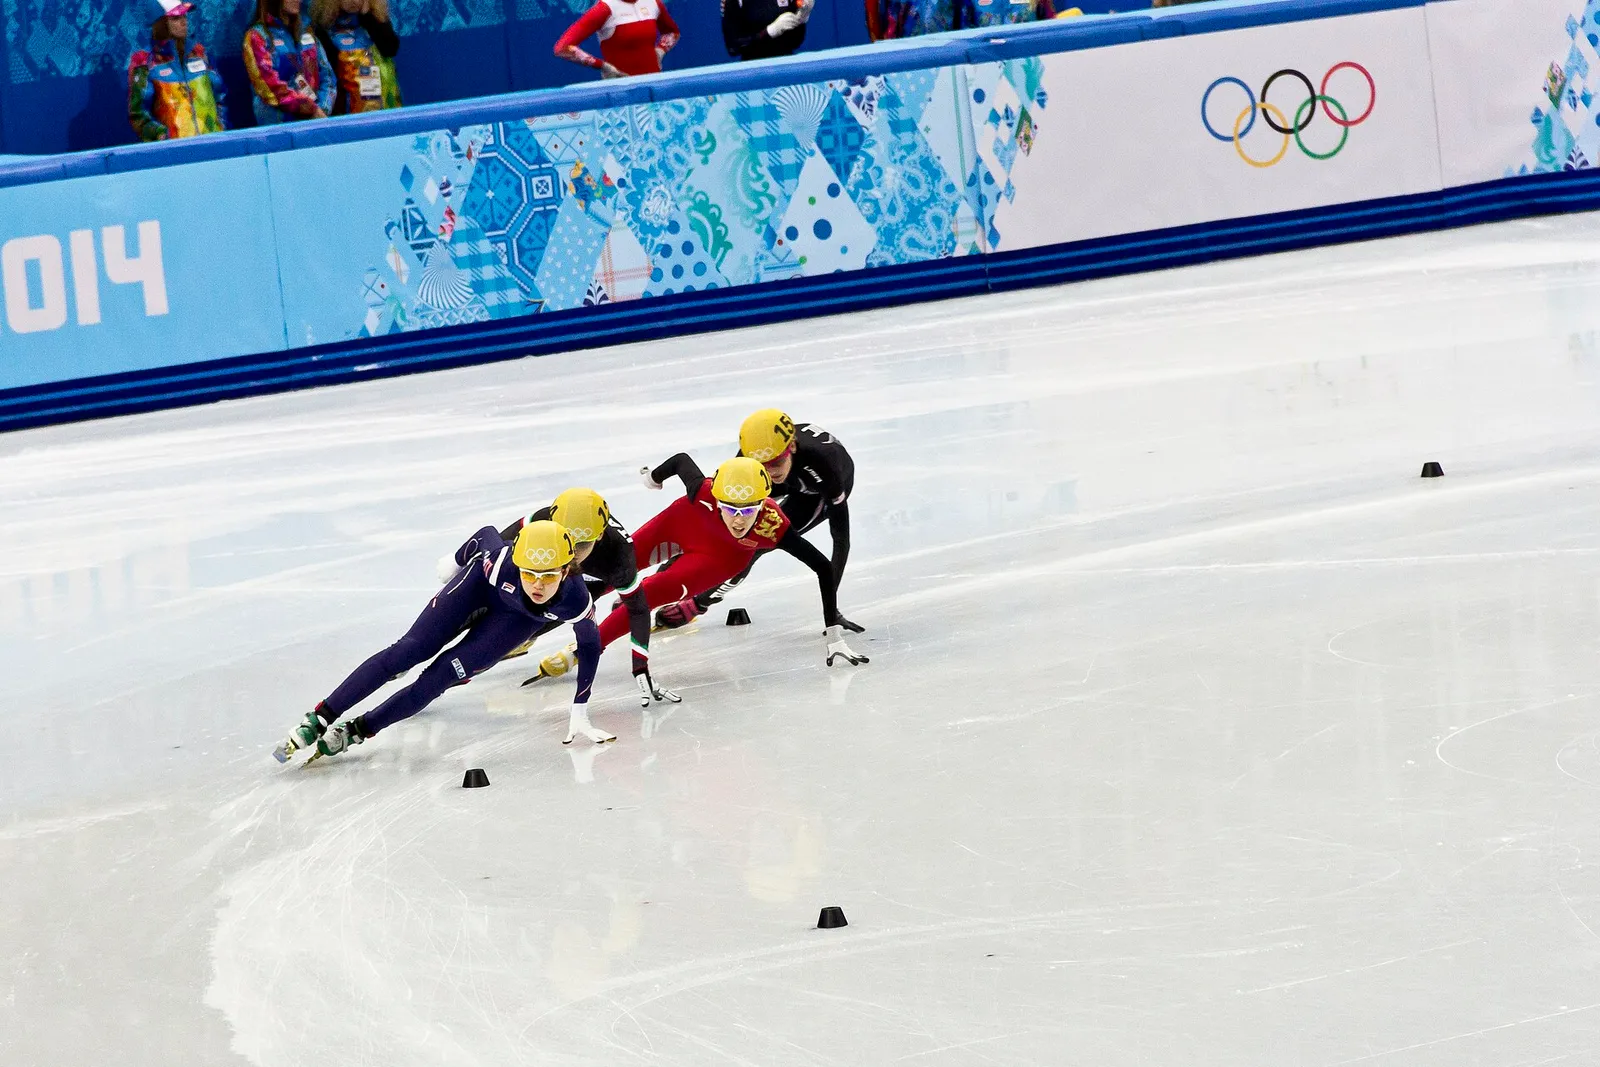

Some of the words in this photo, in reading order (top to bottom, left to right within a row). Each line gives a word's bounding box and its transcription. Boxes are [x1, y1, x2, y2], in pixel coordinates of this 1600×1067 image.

[774, 412, 795, 442] 15
[803, 465, 823, 483] USA
[451, 658, 466, 679] FILA
